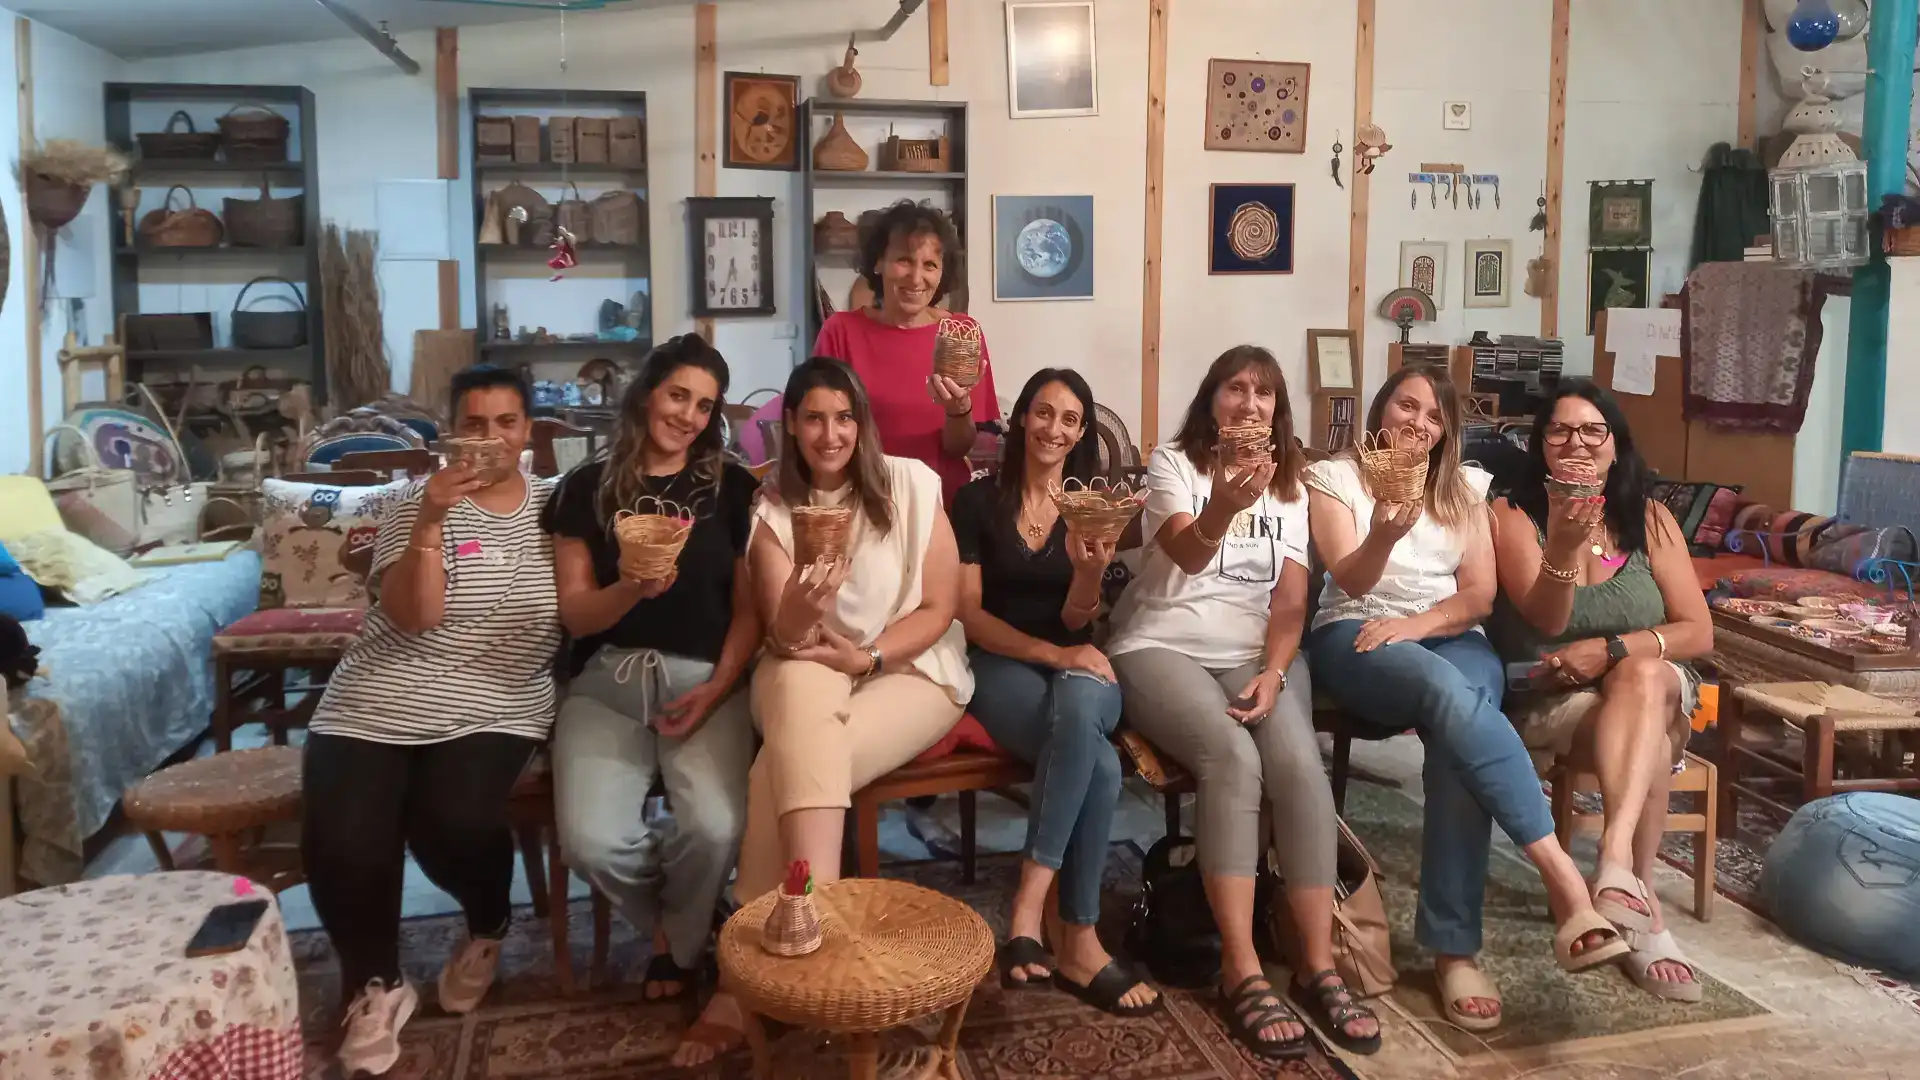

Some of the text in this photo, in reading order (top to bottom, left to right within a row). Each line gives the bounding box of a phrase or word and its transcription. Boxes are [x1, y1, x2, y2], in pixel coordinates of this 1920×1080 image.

[728, 221, 738, 238] 12
[751, 230, 758, 248] 2
[708, 254, 716, 271] 9
[751, 254, 758, 271] 3
[720, 287, 748, 305] 7 6 5
[751, 280, 760, 297] 4
